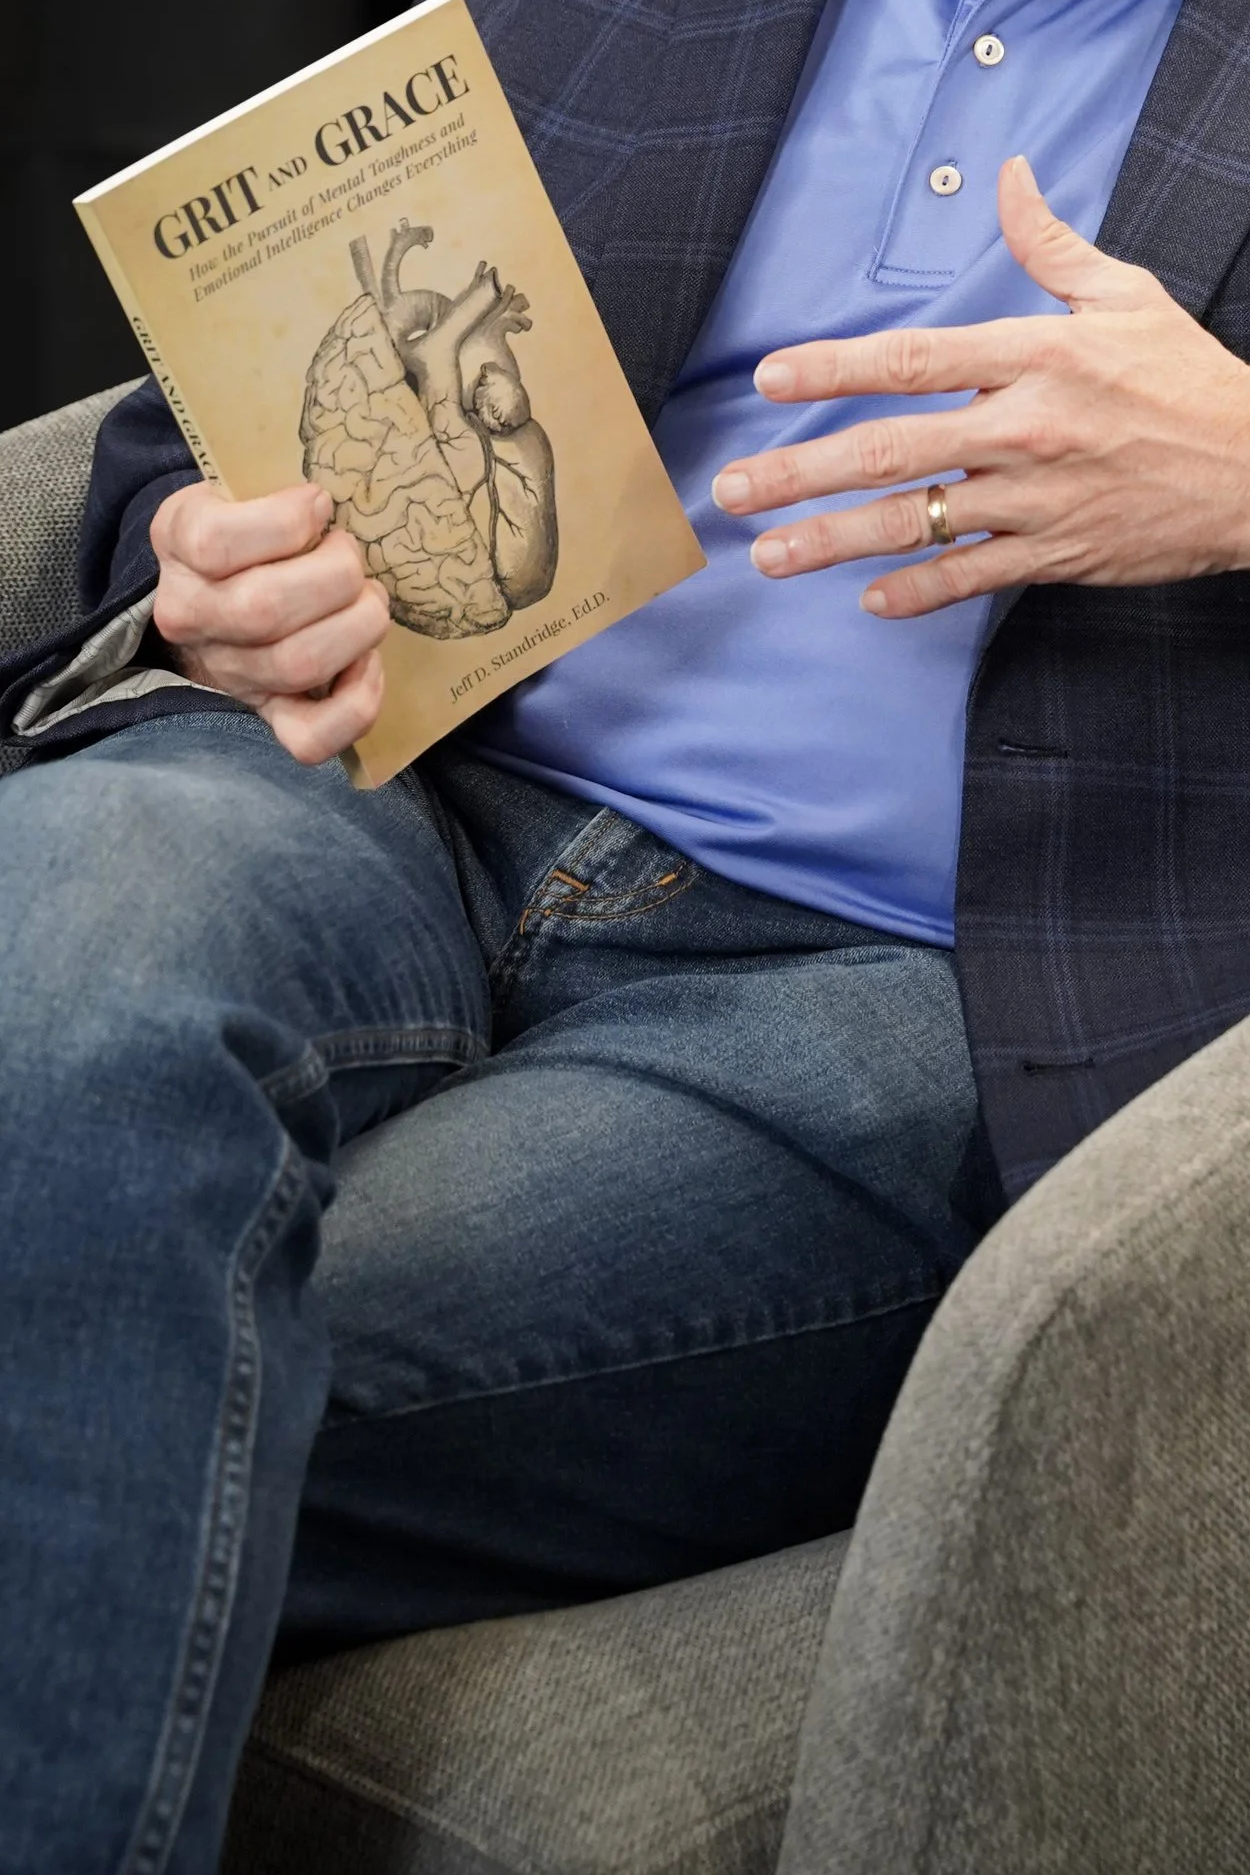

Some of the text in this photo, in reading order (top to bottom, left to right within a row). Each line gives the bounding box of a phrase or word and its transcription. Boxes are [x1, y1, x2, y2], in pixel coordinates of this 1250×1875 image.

[153, 53, 470, 261] GRIT AND GRACE
[188, 111, 466, 283] How the Pursuit of Mental Toughness and
[193, 128, 479, 303] Emotional Intelligence Changes Everything
[132, 316, 222, 487] GRIT AND GRACE
[449, 672, 475, 705] Jeff
[473, 666, 491, 684] D.
[571, 591, 611, 622] Ed.D.
